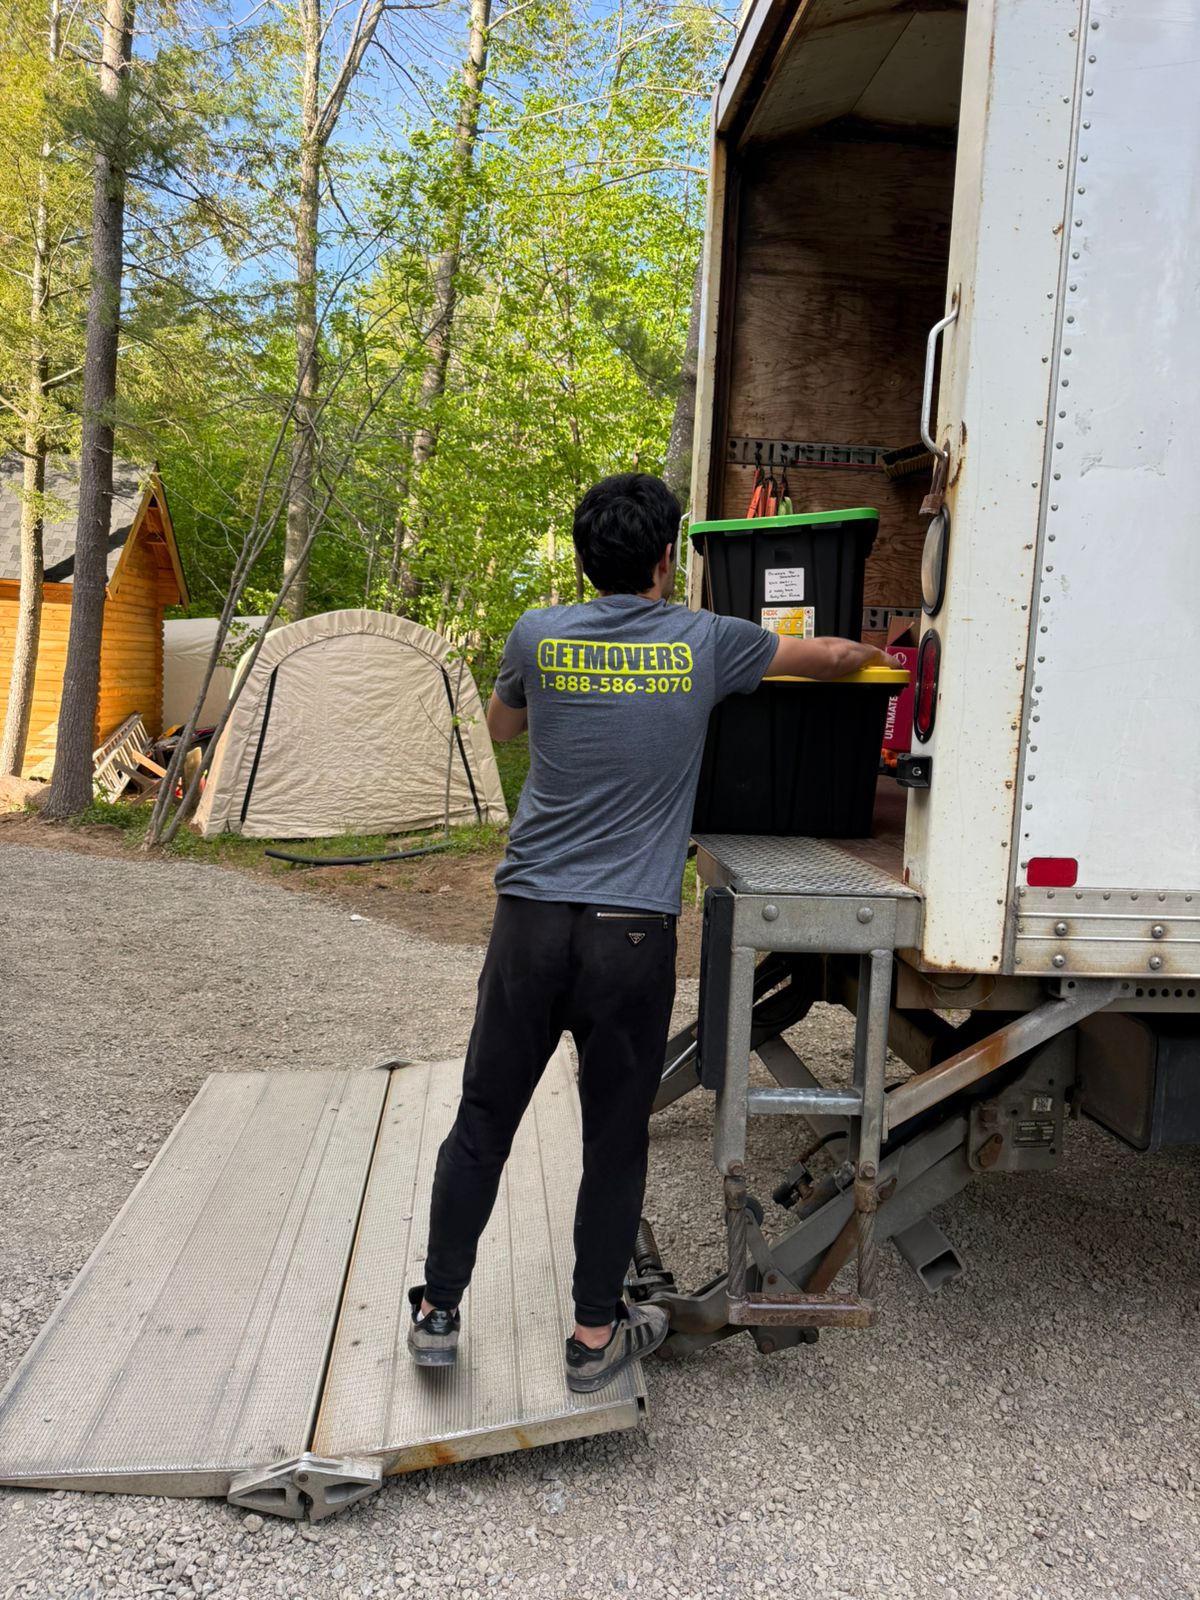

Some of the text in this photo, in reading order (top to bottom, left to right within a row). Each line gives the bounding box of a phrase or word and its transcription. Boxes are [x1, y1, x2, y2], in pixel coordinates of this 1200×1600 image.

[538, 639, 692, 673] GETMOVERS
[540, 674, 693, 693] 1-888-586-3070
[884, 695, 899, 740] ULTIMATE
